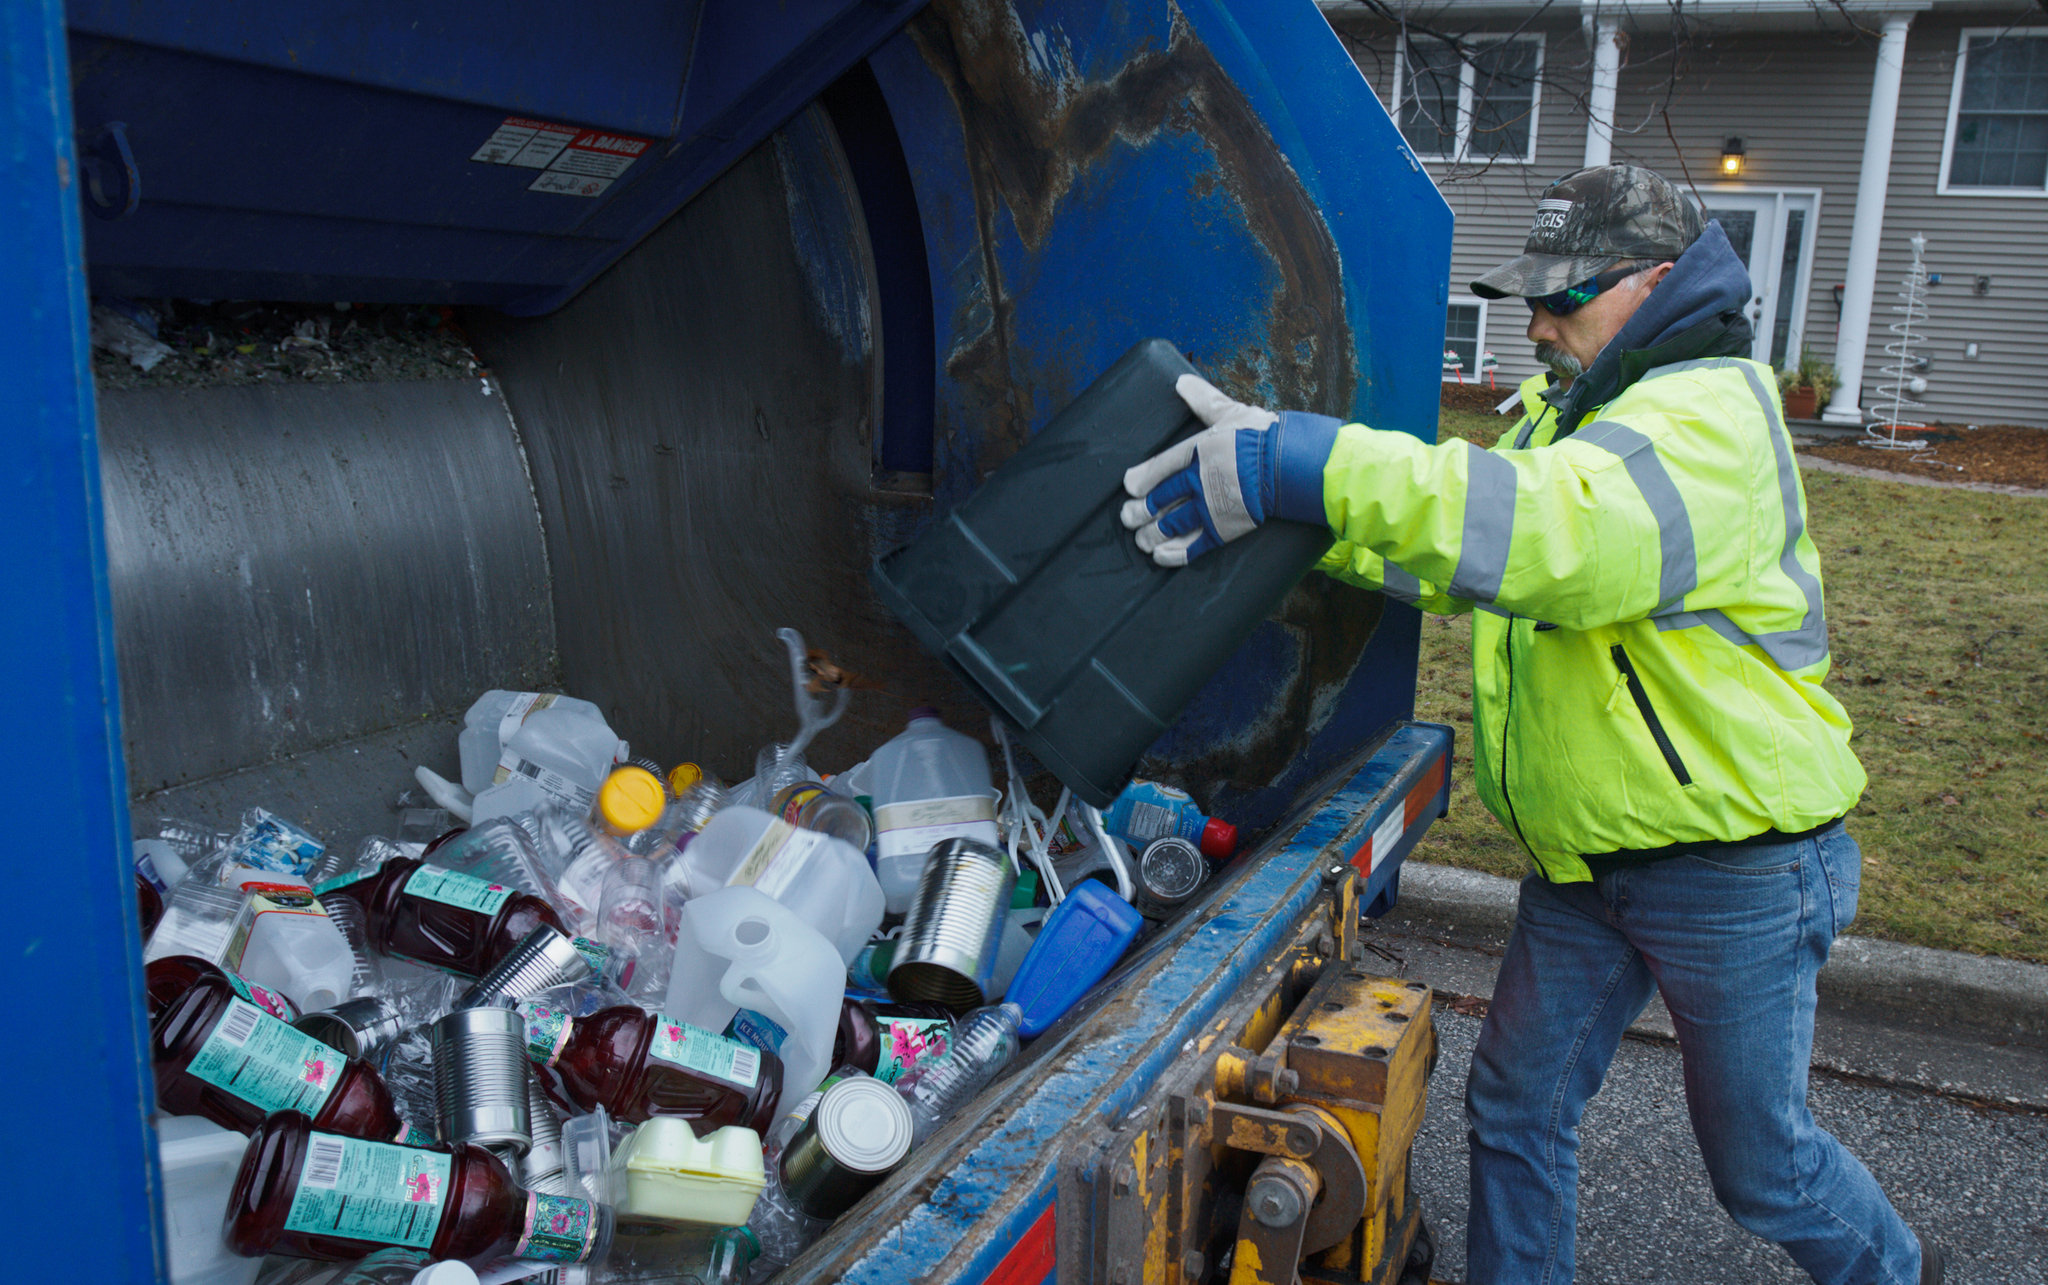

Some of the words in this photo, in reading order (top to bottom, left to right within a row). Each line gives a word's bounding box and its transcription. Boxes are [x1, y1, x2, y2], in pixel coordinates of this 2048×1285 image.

[593, 135, 647, 155] DANGER
[740, 1022, 752, 1034] ICE
[408, 1154, 423, 1183] Green
[424, 1206, 436, 1229] Nutrition
[419, 1229, 431, 1243] Facts
